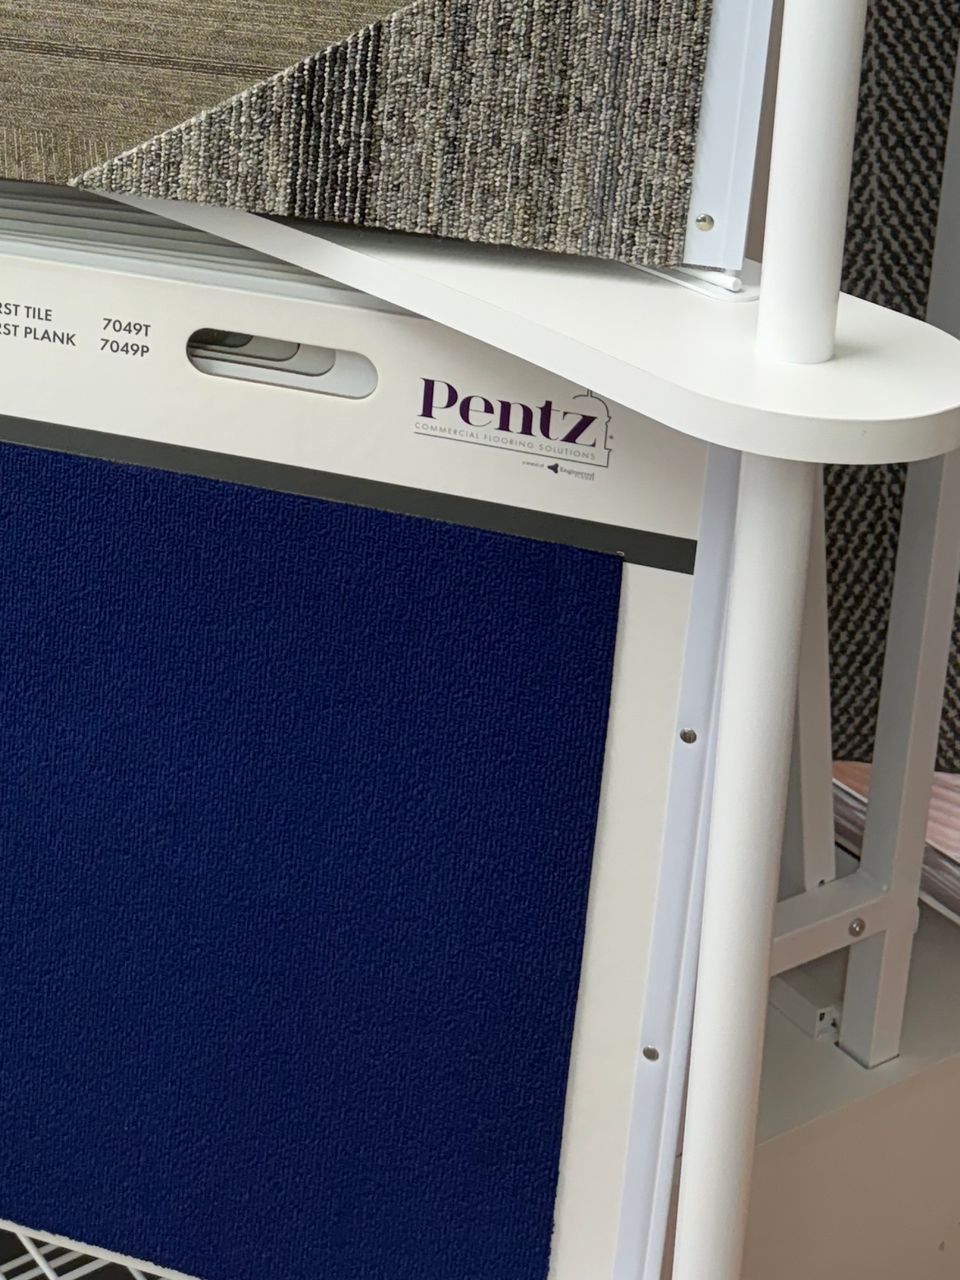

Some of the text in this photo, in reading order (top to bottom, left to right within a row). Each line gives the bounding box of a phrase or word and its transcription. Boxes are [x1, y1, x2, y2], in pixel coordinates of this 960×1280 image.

[24, 305, 53, 322] TILE
[24, 326, 76, 347] PLANK
[102, 317, 151, 337] 7049T
[100, 338, 150, 358] 7049P
[417, 377, 598, 448] Pentz
[414, 421, 597, 461] COMMERCIAL FLOORING SOLUTIONS
